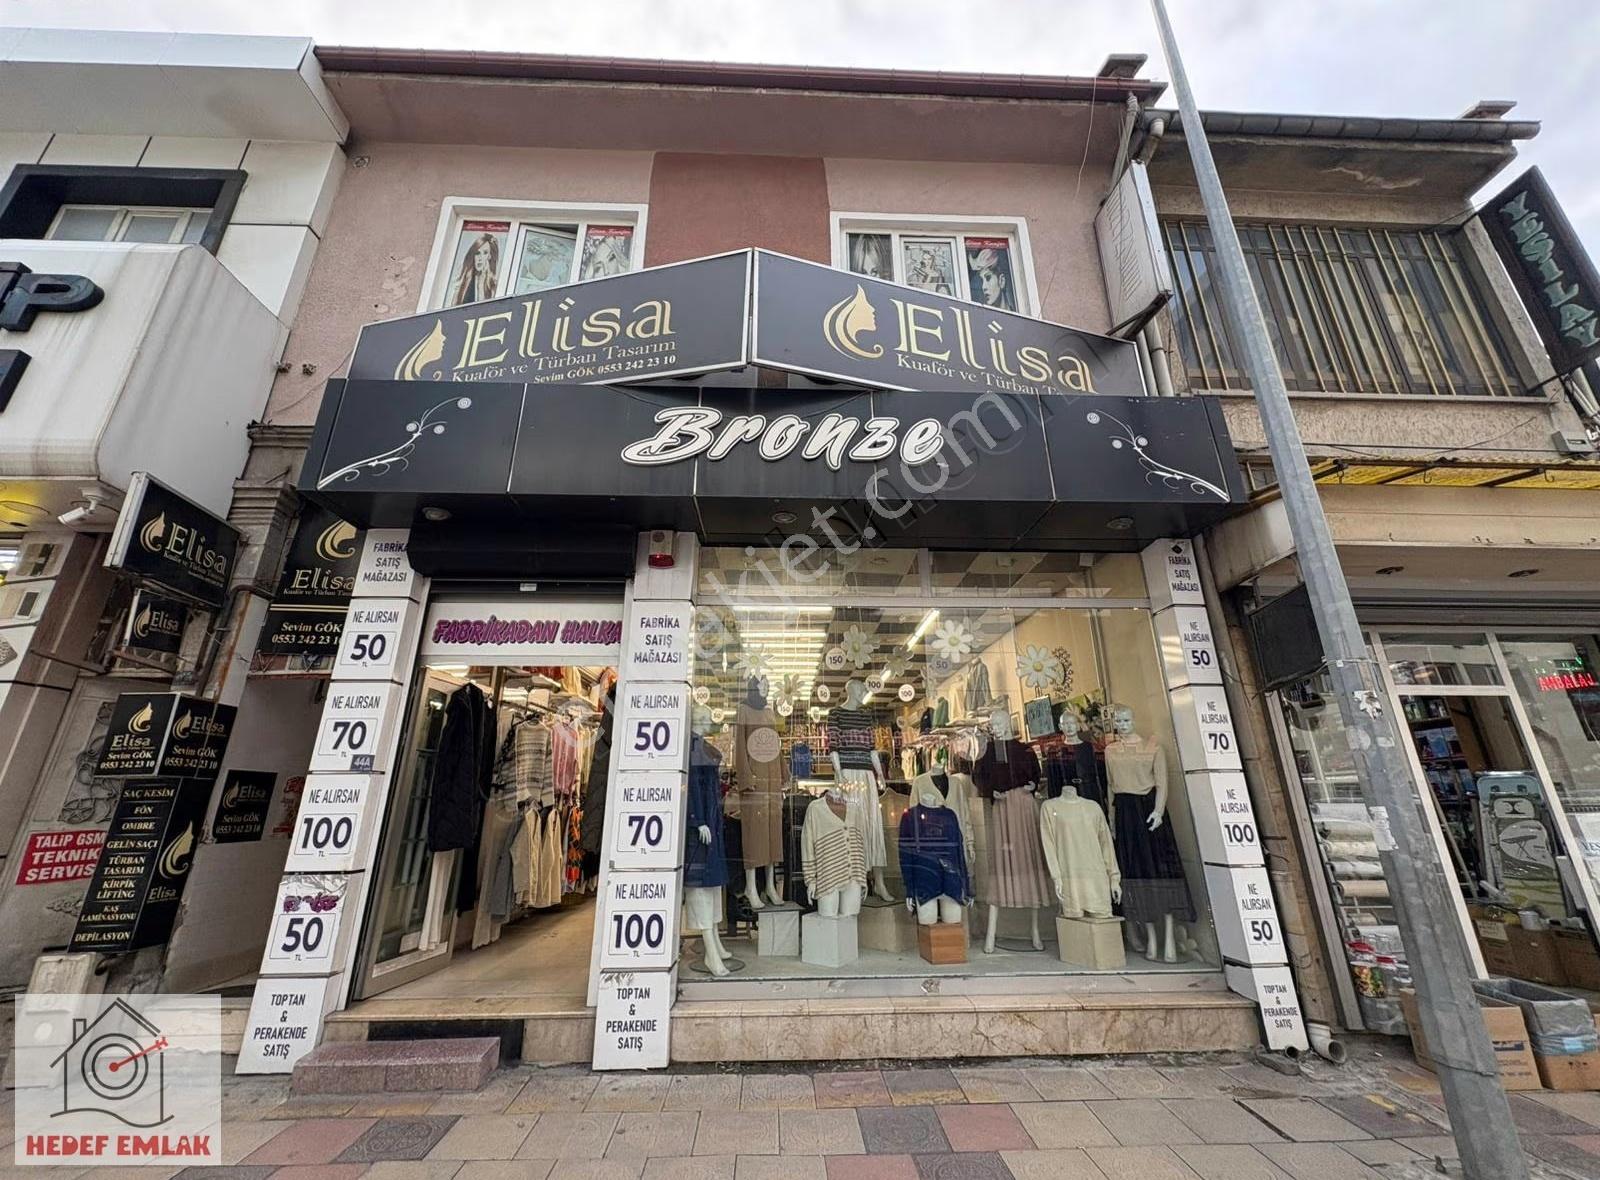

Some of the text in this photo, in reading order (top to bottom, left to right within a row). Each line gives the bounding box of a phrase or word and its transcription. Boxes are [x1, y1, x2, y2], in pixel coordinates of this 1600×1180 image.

[0, 262, 104, 332] P
[453, 297, 677, 370] Elisa
[890, 298, 1100, 394] Elisa
[452, 341, 676, 383] Kuaför ve Türban Tasarım
[896, 353, 955, 378] Kuaför
[959, 371, 977, 383] ve
[534, 355, 676, 384] Sevim GÖK 0553 242 23 10
[621, 406, 943, 471] Bronze
[165, 522, 226, 575] Elisa
[375, 557, 401, 569] SATIŞ
[290, 567, 356, 590] Elisa
[363, 570, 407, 582] MAĞAZASI
[150, 611, 179, 631] Elisa
[352, 611, 399, 624] NE ALIRSAN
[640, 614, 680, 629] FABRİKA
[281, 622, 343, 633] Sevim GÖK
[432, 615, 560, 646] FABRİKADAN
[1189, 621, 1199, 631] NE
[271, 634, 296, 644] 0553
[297, 634, 316, 644] 242
[318, 635, 330, 645] 23
[645, 634, 672, 648] SATIŞ
[1183, 632, 1210, 643] ALIRSAN
[350, 634, 386, 661] 50
[633, 649, 681, 663] MAĞAZASI
[829, 655, 843, 664] 150
[1191, 650, 1211, 666] 50
[935, 660, 948, 669] 50
[868, 681, 881, 689] 100
[1538, 673, 1599, 691] AMBALAJ
[331, 696, 380, 709] NE ALIRSAN
[630, 695, 679, 709] NE ALIRSAN
[1206, 701, 1216, 711] NE
[191, 716, 225, 733] Elisa
[1200, 712, 1229, 724] ALIRSAN
[111, 734, 151, 748] Elisa
[332, 721, 367, 750] 70
[634, 721, 670, 751] 50
[1208, 733, 1230, 751] 70
[107, 750, 152, 760] Sevim GÖK
[172, 745, 217, 758] Sevim GÖK
[100, 761, 118, 769] 0553
[119, 761, 133, 769] 242
[146, 760, 155, 768] 10
[164, 757, 183, 768] 0553
[209, 761, 218, 769] 10
[123, 788, 175, 798] SAÇ KESİM
[308, 789, 360, 804] NE ALIRSAN
[623, 787, 672, 802] NE ALIRSAN
[1226, 789, 1236, 800] NE
[133, 805, 154, 815] FÖN
[1220, 802, 1249, 814] ALIRSAN
[121, 821, 156, 830] OMBRE
[628, 815, 663, 847] 70
[76, 831, 106, 846] GSM
[301, 816, 352, 849] 100
[1224, 823, 1254, 844] 100
[106, 839, 159, 850] GELİN SAÇI
[108, 855, 146, 865] TÜRBAN
[103, 866, 145, 875] TASARIM
[102, 879, 136, 889] KİRPİK
[1247, 884, 1258, 895] NE
[96, 889, 136, 899] LİFTİNG
[148, 886, 177, 900] Elisa
[615, 884, 666, 899] NE ALIRSAN
[1241, 898, 1271, 911] ALIRSAN
[74, 931, 131, 942] DEPİLASYON
[281, 916, 324, 952] 50
[613, 913, 664, 949] 100
[1251, 920, 1273, 941] 50
[616, 988, 650, 1000] TOPTAN
[1263, 985, 1287, 994] TOPTAN
[270, 994, 306, 1006] TOPTAN
[628, 1003, 636, 1015] &
[1263, 1007, 1298, 1016] PERAKENDE
[280, 1010, 288, 1022] &
[606, 1020, 657, 1032] PERAKENDE
[1274, 1019, 1293, 1030] SATIŞ
[253, 1027, 307, 1040] PERAKENDE
[617, 1037, 643, 1052] SATIŞ
[262, 1044, 290, 1059] SATIŞ
